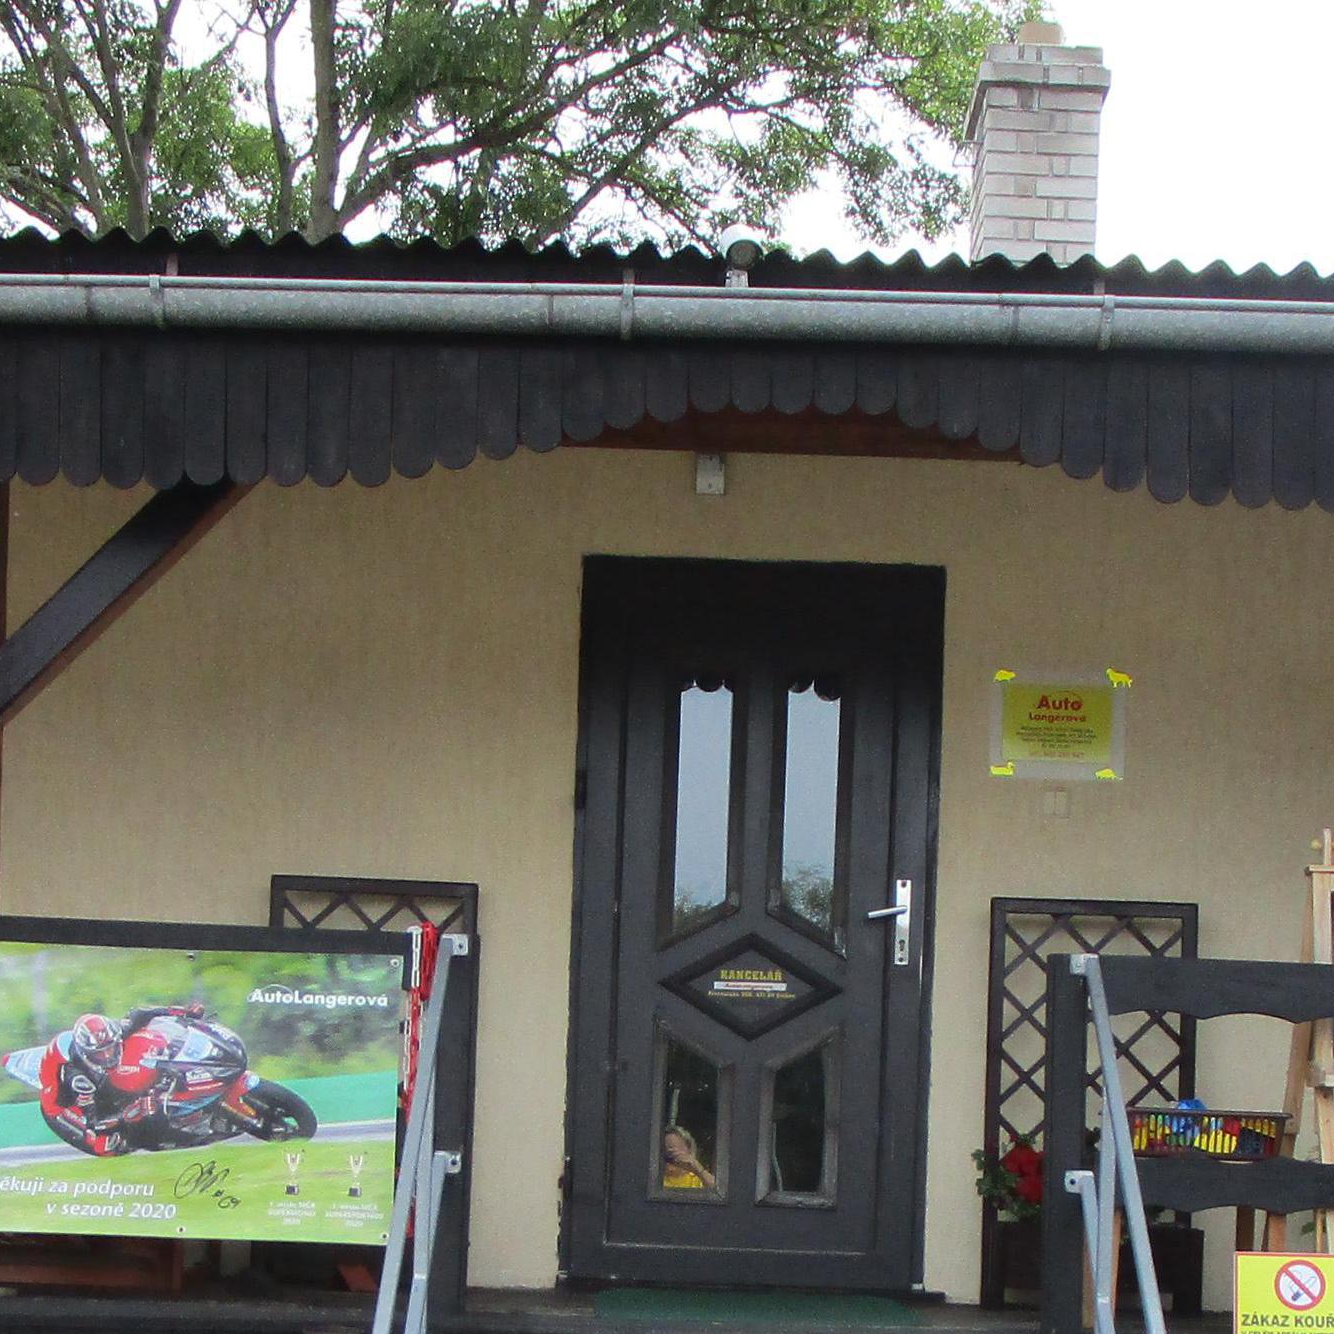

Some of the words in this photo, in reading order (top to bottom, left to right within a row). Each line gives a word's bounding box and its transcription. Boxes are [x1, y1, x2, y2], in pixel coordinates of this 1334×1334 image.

[1036, 695, 1082, 711] Auto
[49, 1180, 68, 1193] za
[73, 1179, 155, 1198] podporu
[46, 1202, 57, 1214] v
[128, 1202, 177, 1220] 2020
[1241, 1311, 1290, 1327] ZÁKAZ
